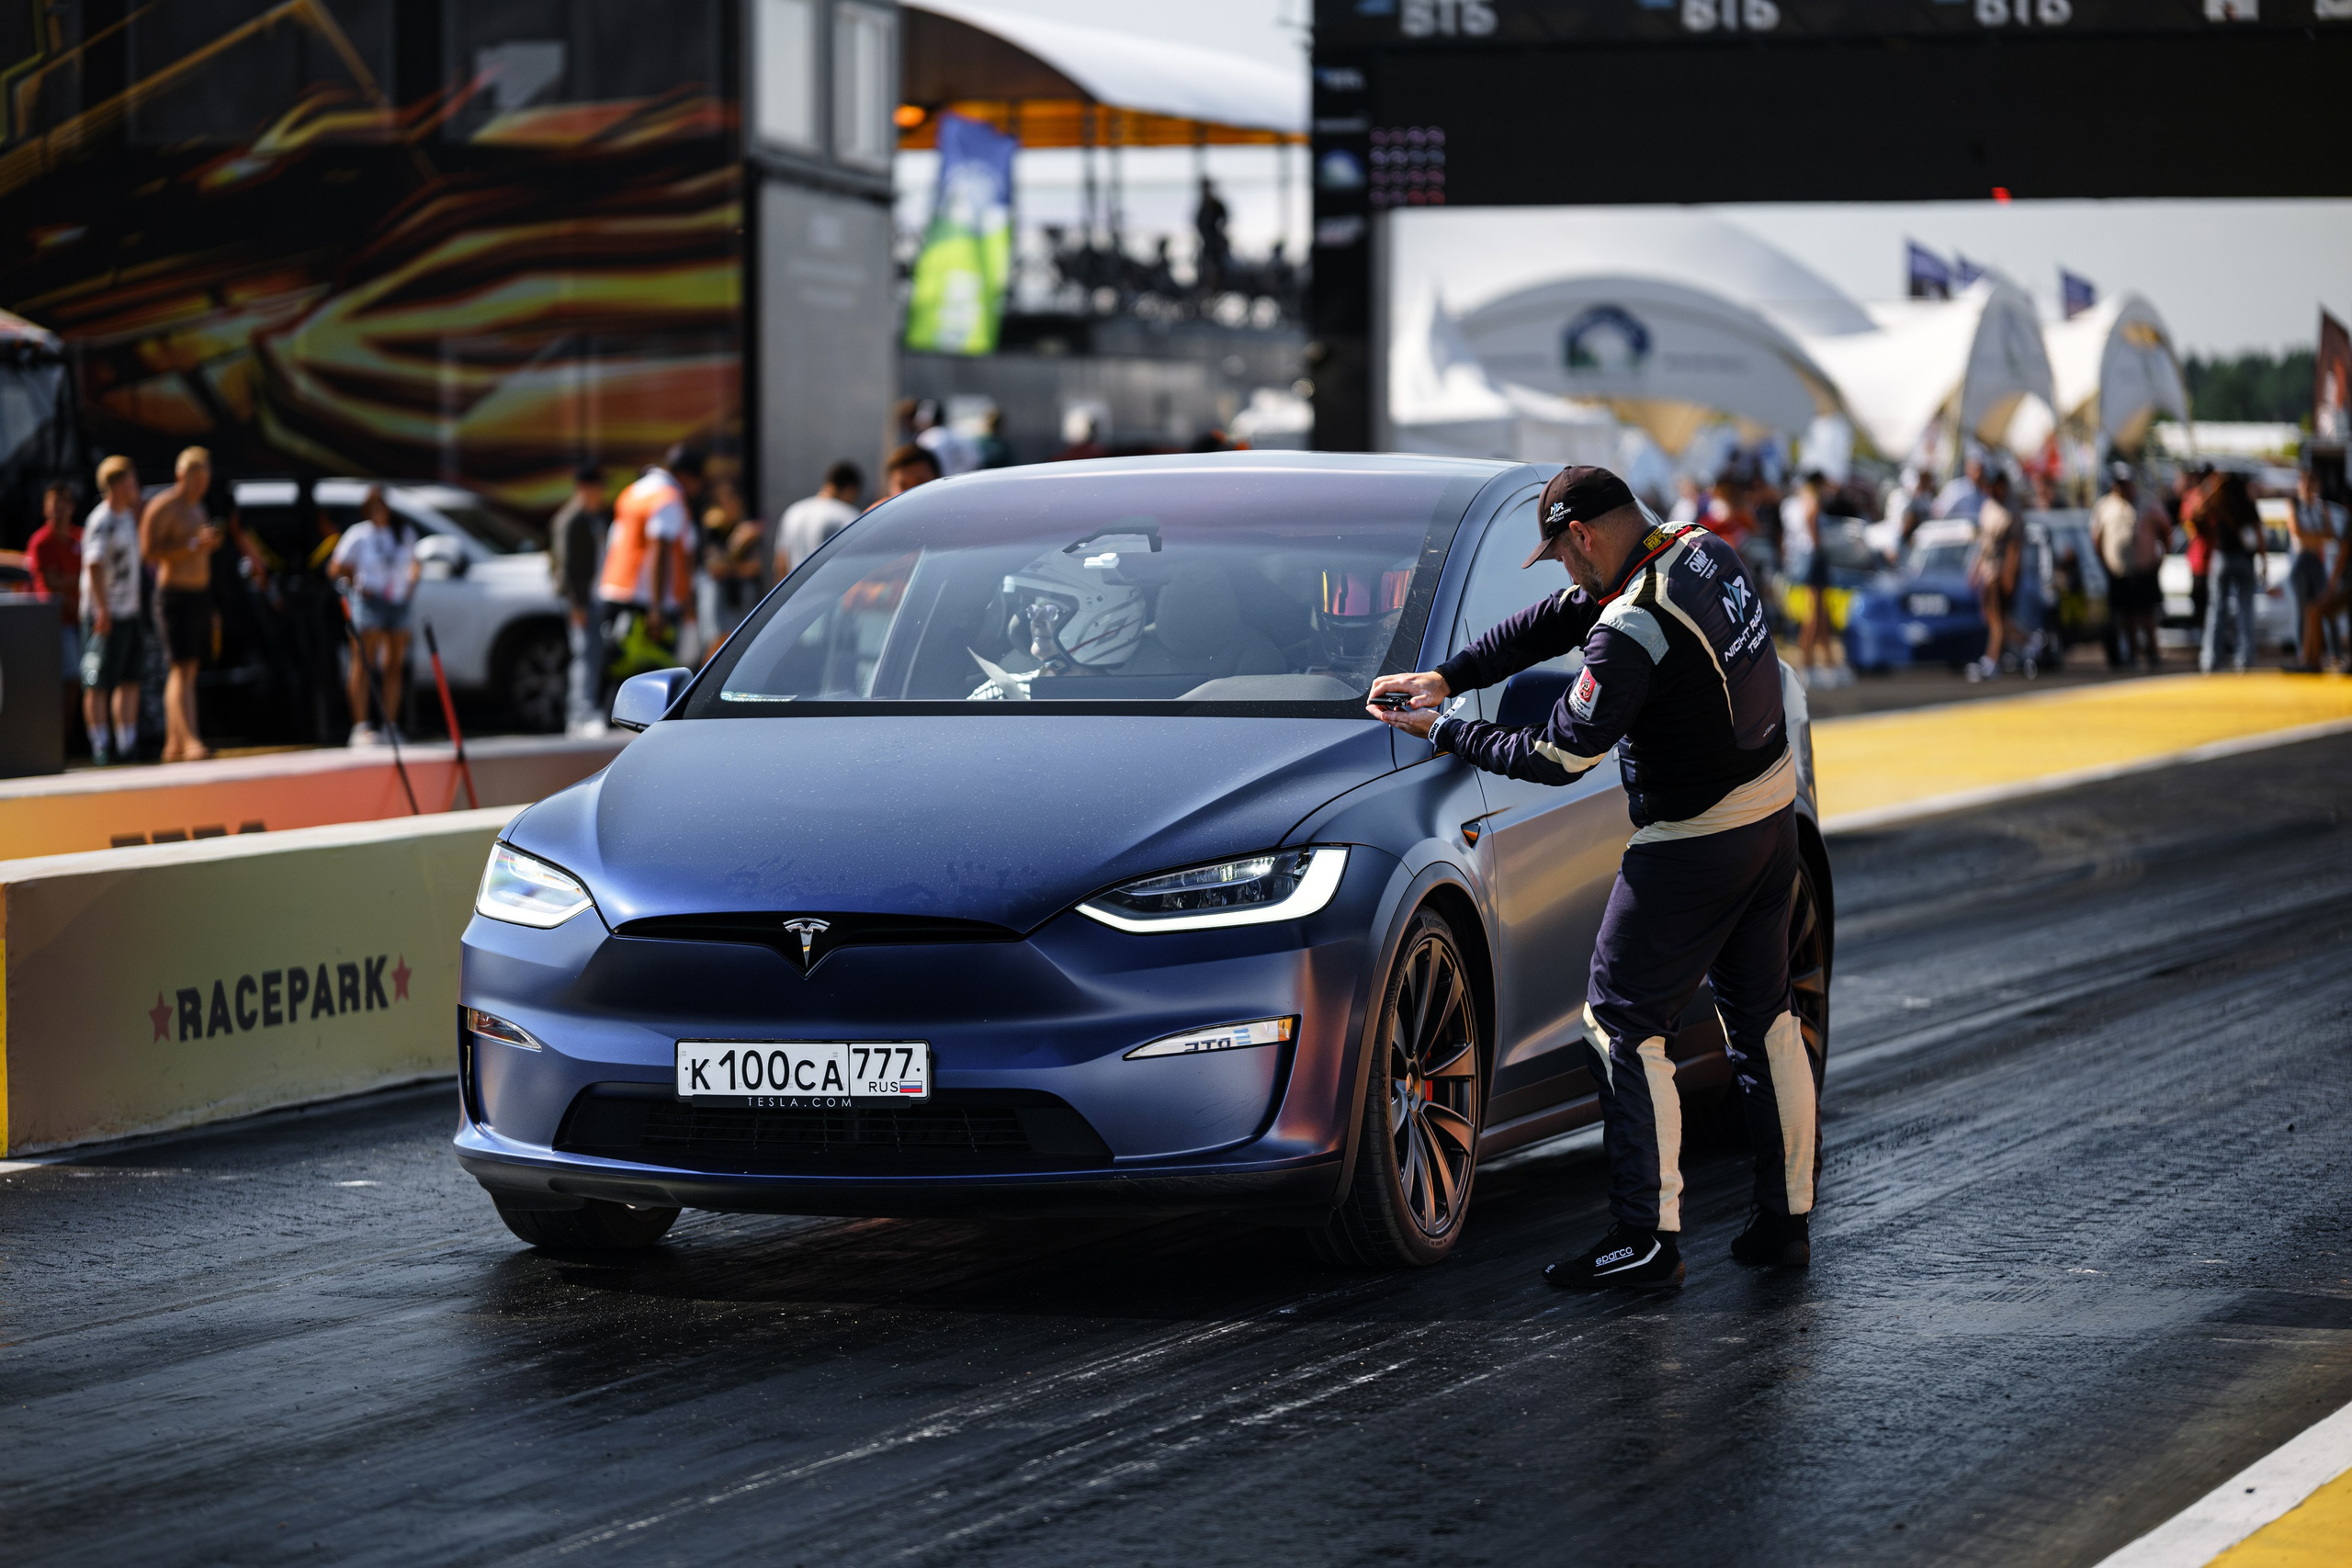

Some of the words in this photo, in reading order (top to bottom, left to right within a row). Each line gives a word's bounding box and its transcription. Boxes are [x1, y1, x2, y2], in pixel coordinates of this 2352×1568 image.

[1689, 549, 1710, 573] OMP
[1724, 626, 1749, 662] NIGHT
[1747, 623, 1768, 654] TEAM
[175, 953, 390, 1042] RACEPARK
[852, 1047, 913, 1079] 777
[868, 1081, 899, 1093] RUS
[747, 1097, 852, 1108] TESLA.COM
[1595, 1247, 1634, 1267] sparco
